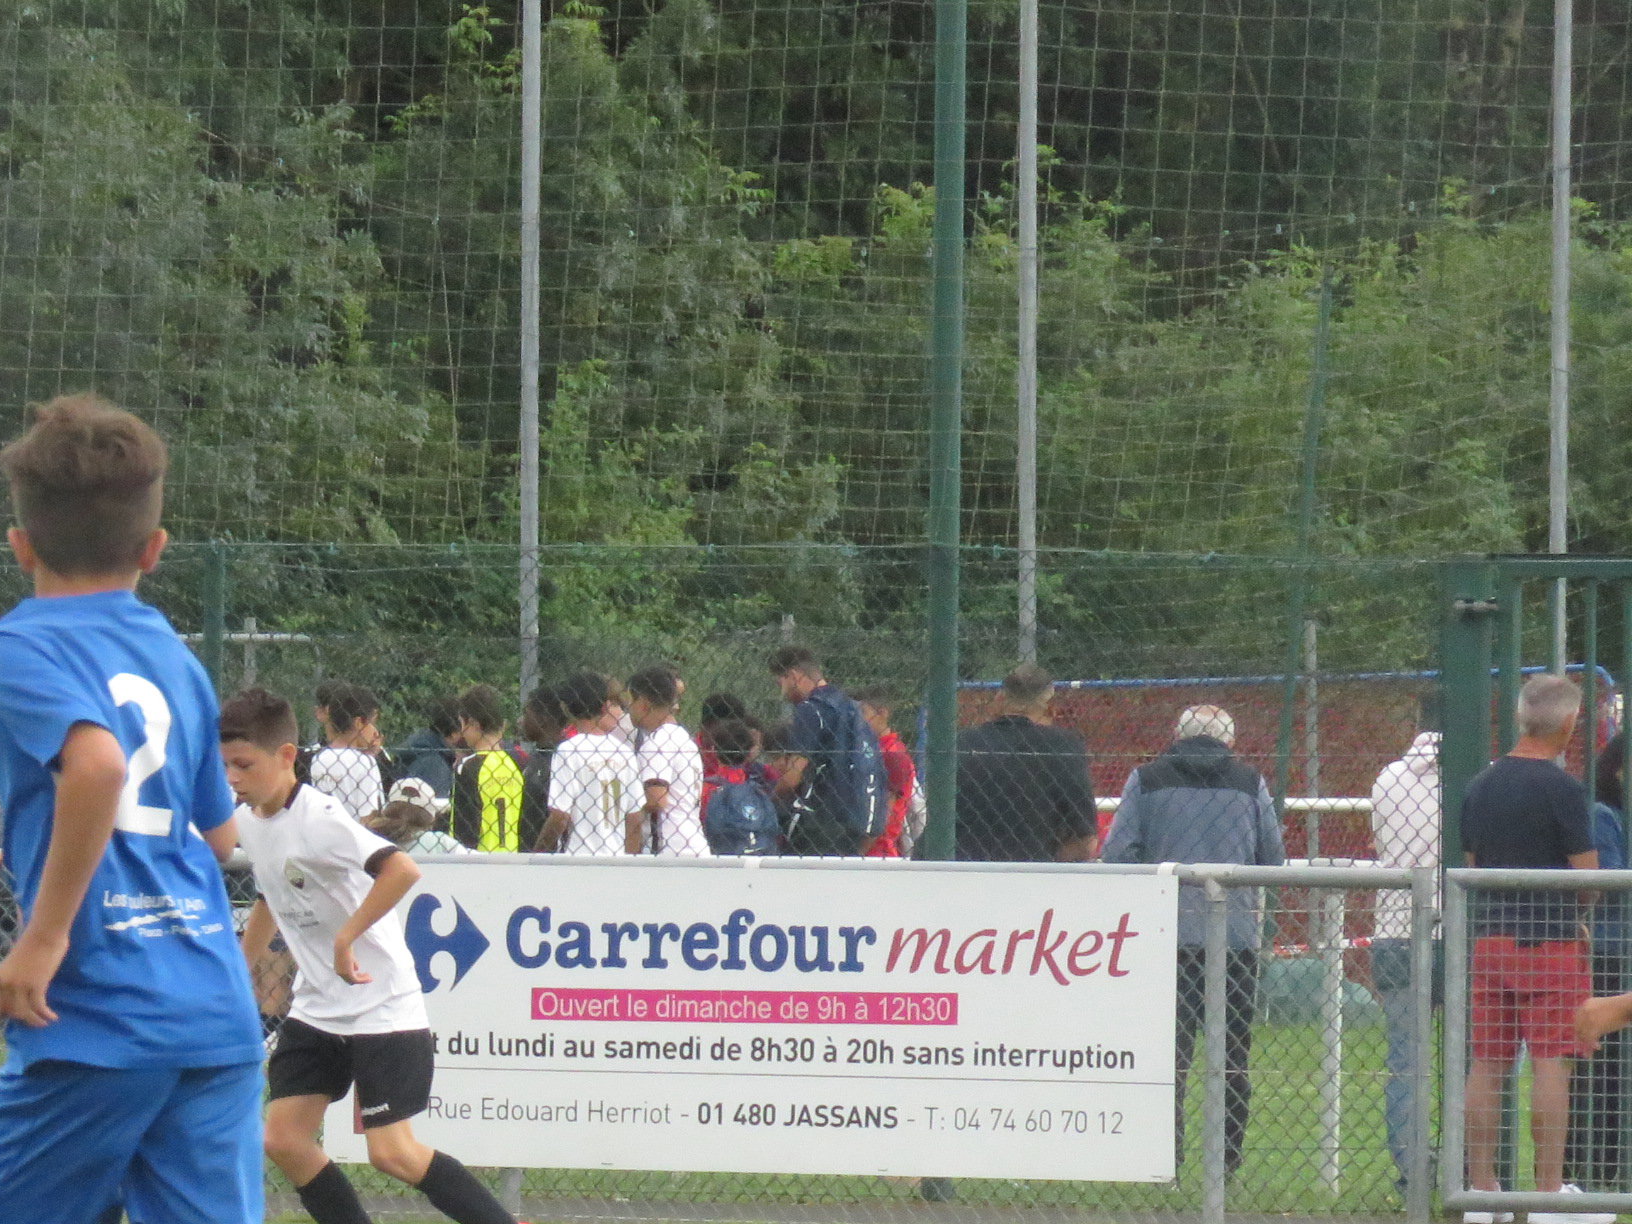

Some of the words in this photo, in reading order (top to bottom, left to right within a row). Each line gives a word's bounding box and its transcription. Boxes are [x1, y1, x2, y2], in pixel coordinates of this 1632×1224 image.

[107, 672, 172, 837] 2
[506, 905, 876, 974] Carrefour
[885, 908, 1139, 985] market
[538, 991, 619, 1017] Ouvert
[627, 993, 648, 1018] le
[655, 994, 772, 1019] dimanche
[779, 995, 809, 1020] de
[818, 996, 846, 1020] 9h
[854, 997, 868, 1020] à
[879, 997, 951, 1021] 12h30
[448, 1031, 479, 1055] du
[489, 1031, 554, 1057] lundi
[563, 1039, 595, 1058] au
[604, 1036, 701, 1060] samedi
[710, 1036, 742, 1061] de
[750, 1037, 815, 1062] 8h30
[823, 1036, 837, 1063] à
[846, 1038, 894, 1064] 20h
[903, 1046, 964, 1066] sans
[973, 1041, 1135, 1074] interruption
[428, 1096, 471, 1119] Rue
[481, 1097, 578, 1122] Edouard
[588, 1100, 671, 1124] Herriot
[698, 1103, 723, 1125] 01
[733, 1103, 776, 1126] 480
[783, 1104, 899, 1128] JASSANS
[925, 1106, 945, 1130] T:
[954, 1107, 981, 1131] 04
[990, 1108, 1017, 1131] 74
[1025, 1109, 1052, 1132] 60
[1061, 1110, 1088, 1133] 70
[1098, 1111, 1124, 1134] 12
